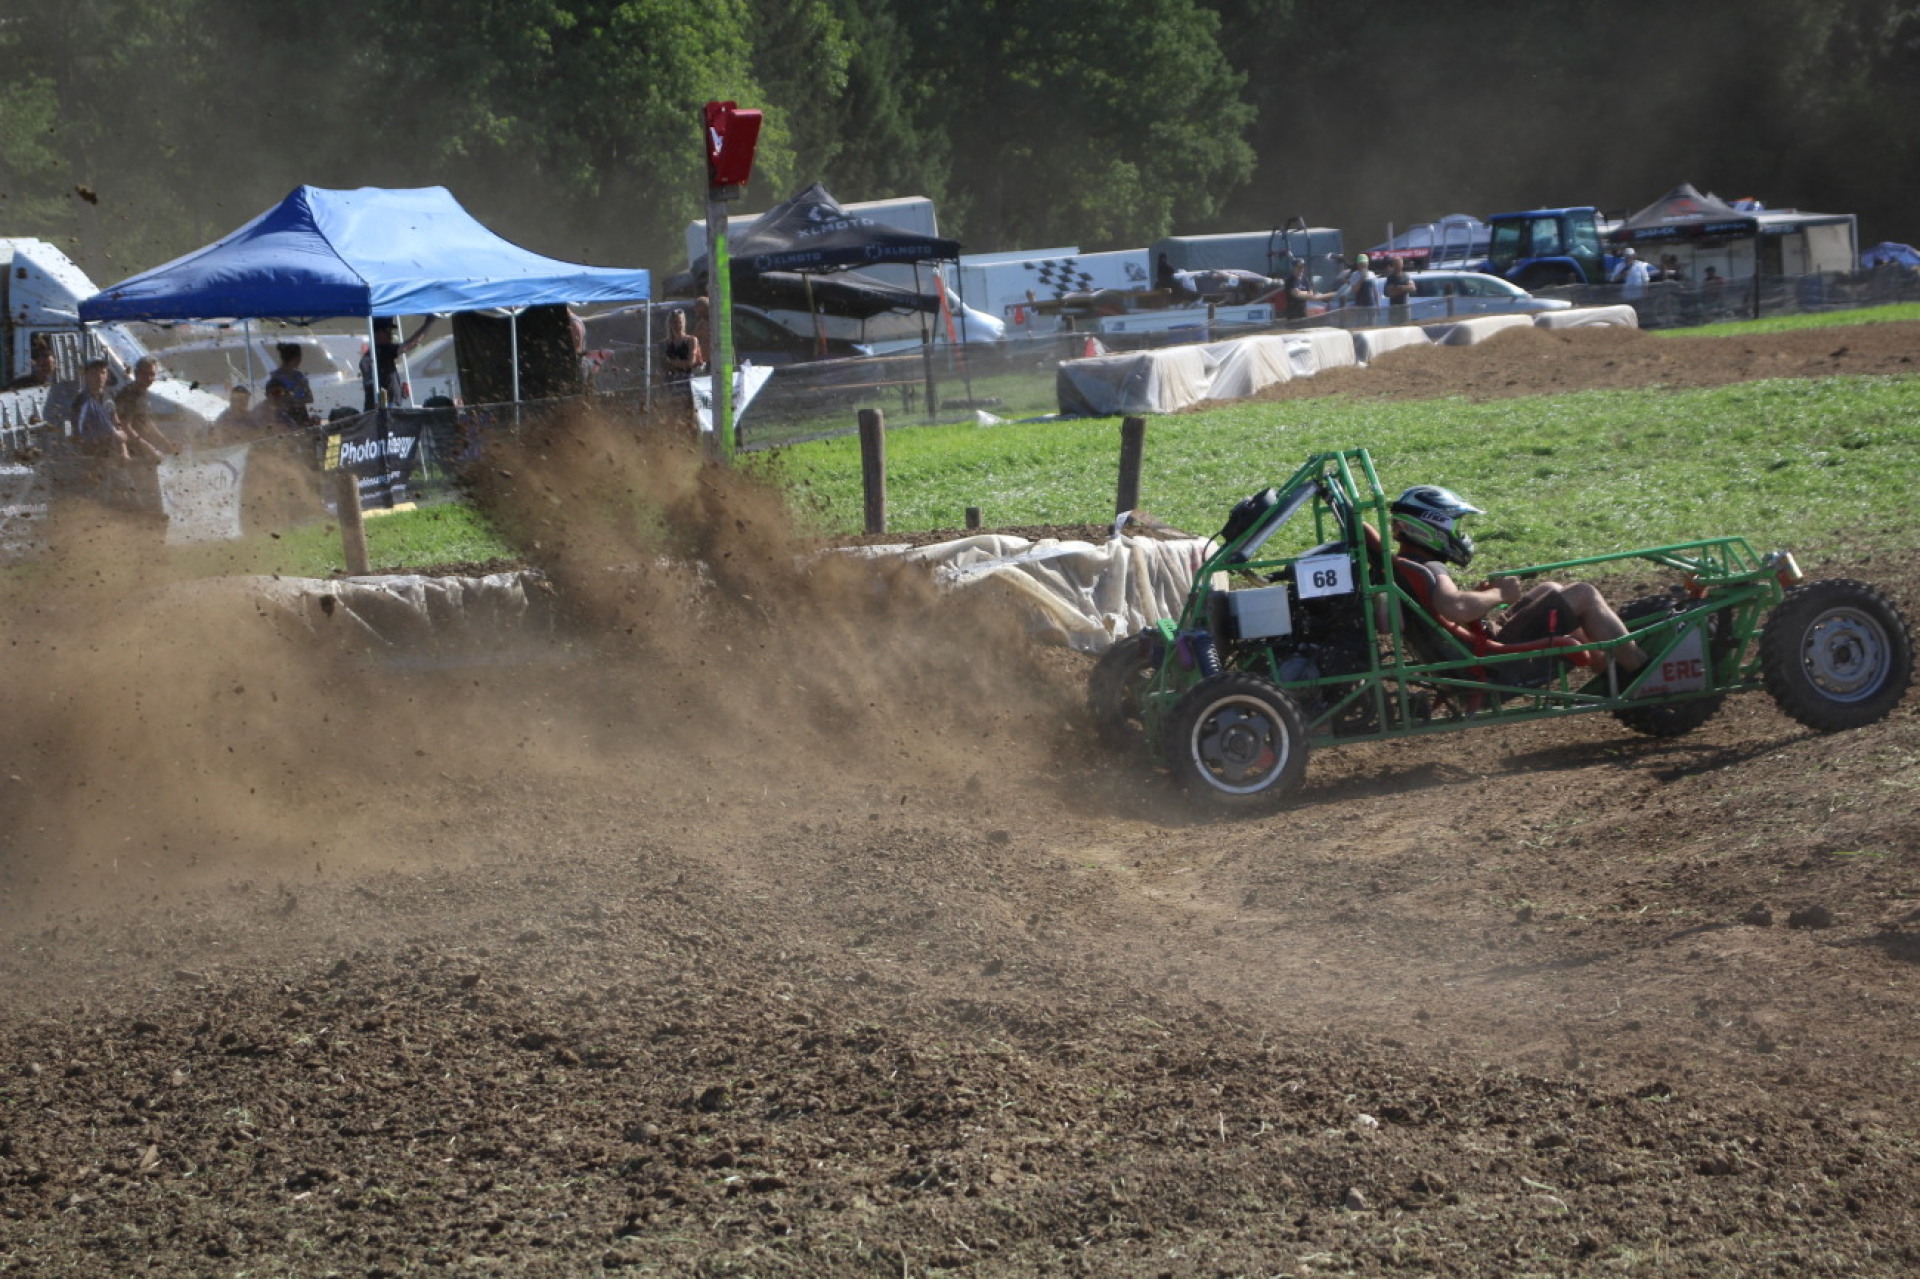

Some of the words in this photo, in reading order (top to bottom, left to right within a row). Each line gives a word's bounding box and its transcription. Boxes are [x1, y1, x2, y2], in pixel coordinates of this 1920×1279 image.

[798, 218, 875, 239] XLMOTO
[773, 252, 822, 265] XLMOTO
[883, 246, 932, 256] XLMOTO
[1312, 569, 1338, 589] 68
